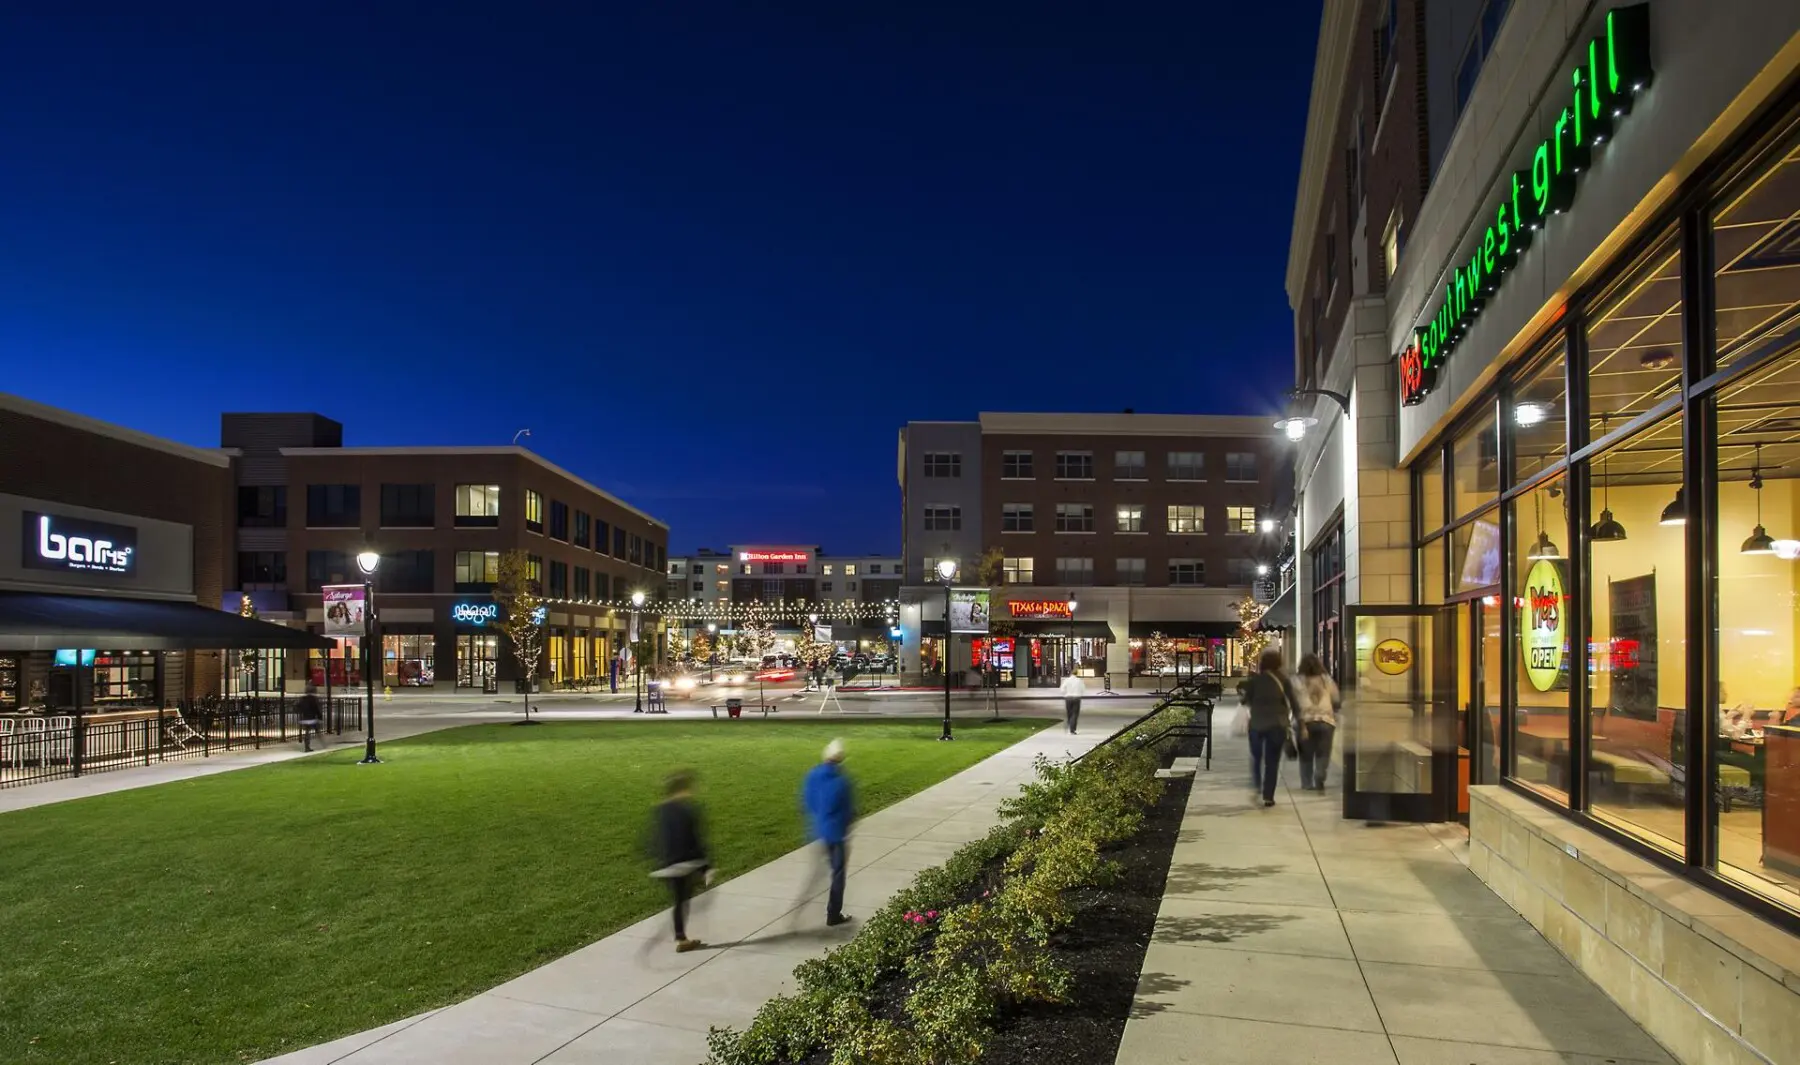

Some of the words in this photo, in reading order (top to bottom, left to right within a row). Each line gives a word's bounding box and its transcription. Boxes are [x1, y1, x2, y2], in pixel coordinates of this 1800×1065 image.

[1422, 172, 1520, 369] southwest
[1533, 11, 1619, 214] grill
[1008, 602, 1035, 616] TEXAS
[1042, 602, 1072, 616] BRAZIL
[1531, 648, 1556, 668] OPEN
